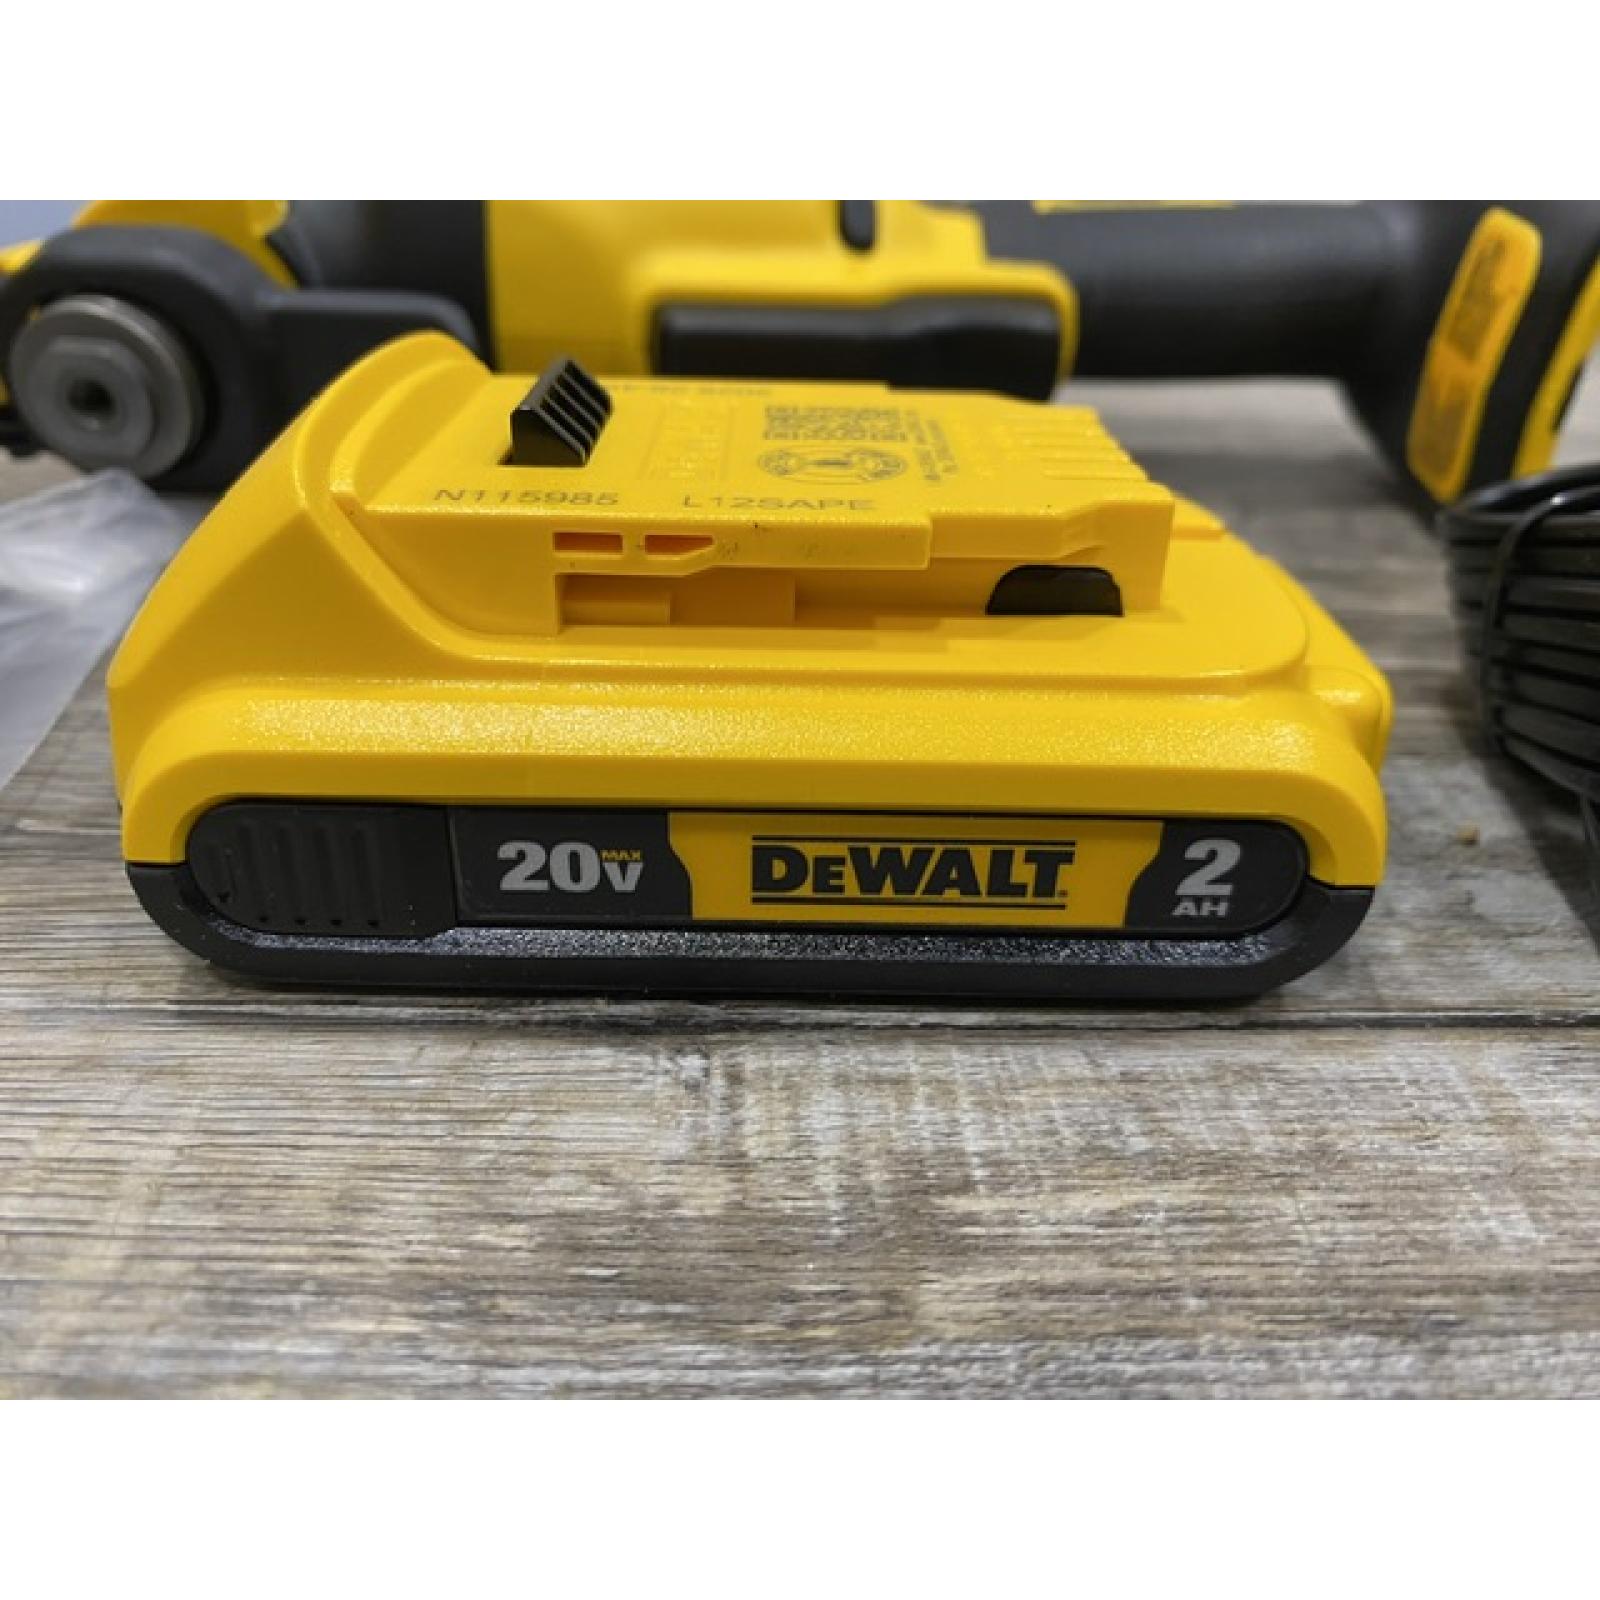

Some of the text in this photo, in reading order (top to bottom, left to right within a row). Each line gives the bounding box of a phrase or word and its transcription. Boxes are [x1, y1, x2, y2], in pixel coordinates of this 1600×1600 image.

[433, 489, 620, 506] N115985
[601, 849, 642, 861] MAX
[751, 844, 1076, 898] DEWALT
[1175, 838, 1242, 896] 2
[1171, 897, 1229, 917] AH
